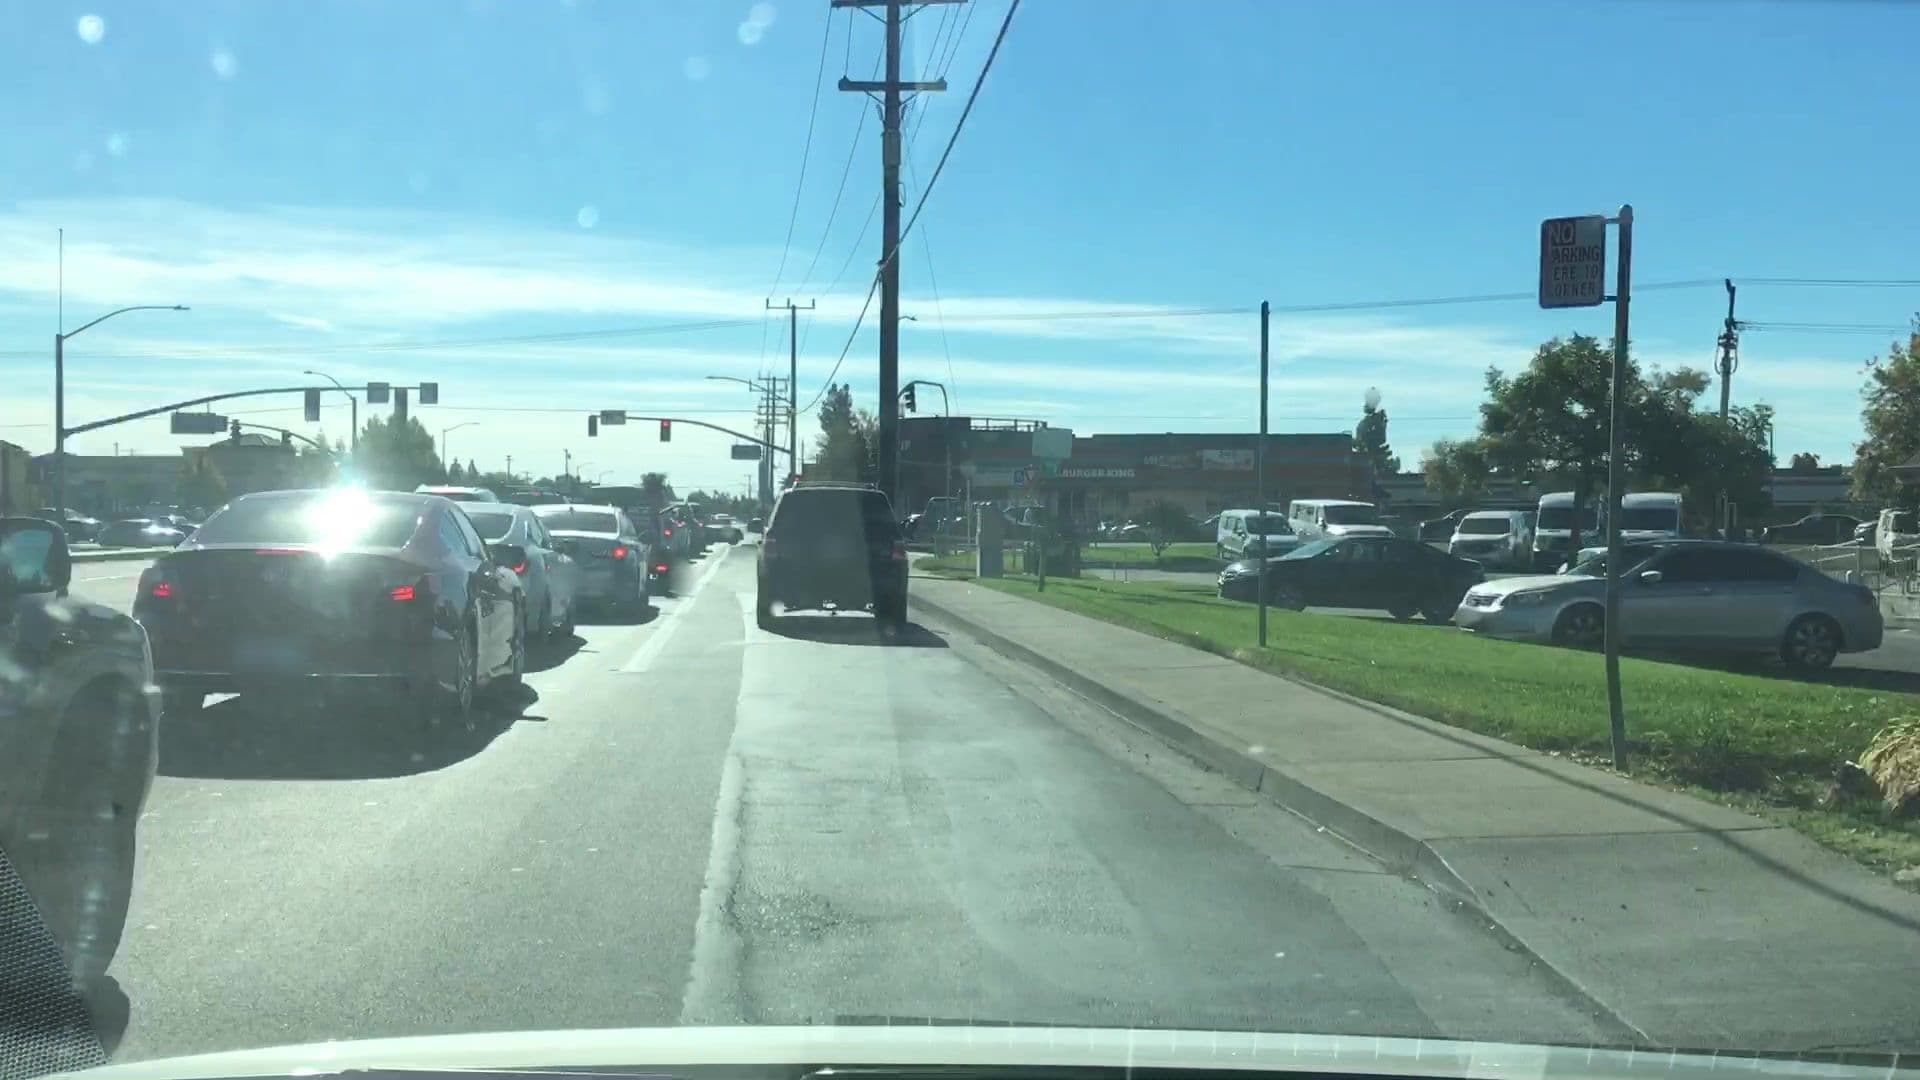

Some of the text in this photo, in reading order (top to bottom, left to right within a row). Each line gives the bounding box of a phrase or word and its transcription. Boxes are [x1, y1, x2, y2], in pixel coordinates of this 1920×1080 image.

[1551, 223, 1573, 243] NO
[1550, 244, 1600, 263] ARKING
[1062, 468, 1136, 478] BURGER KING
